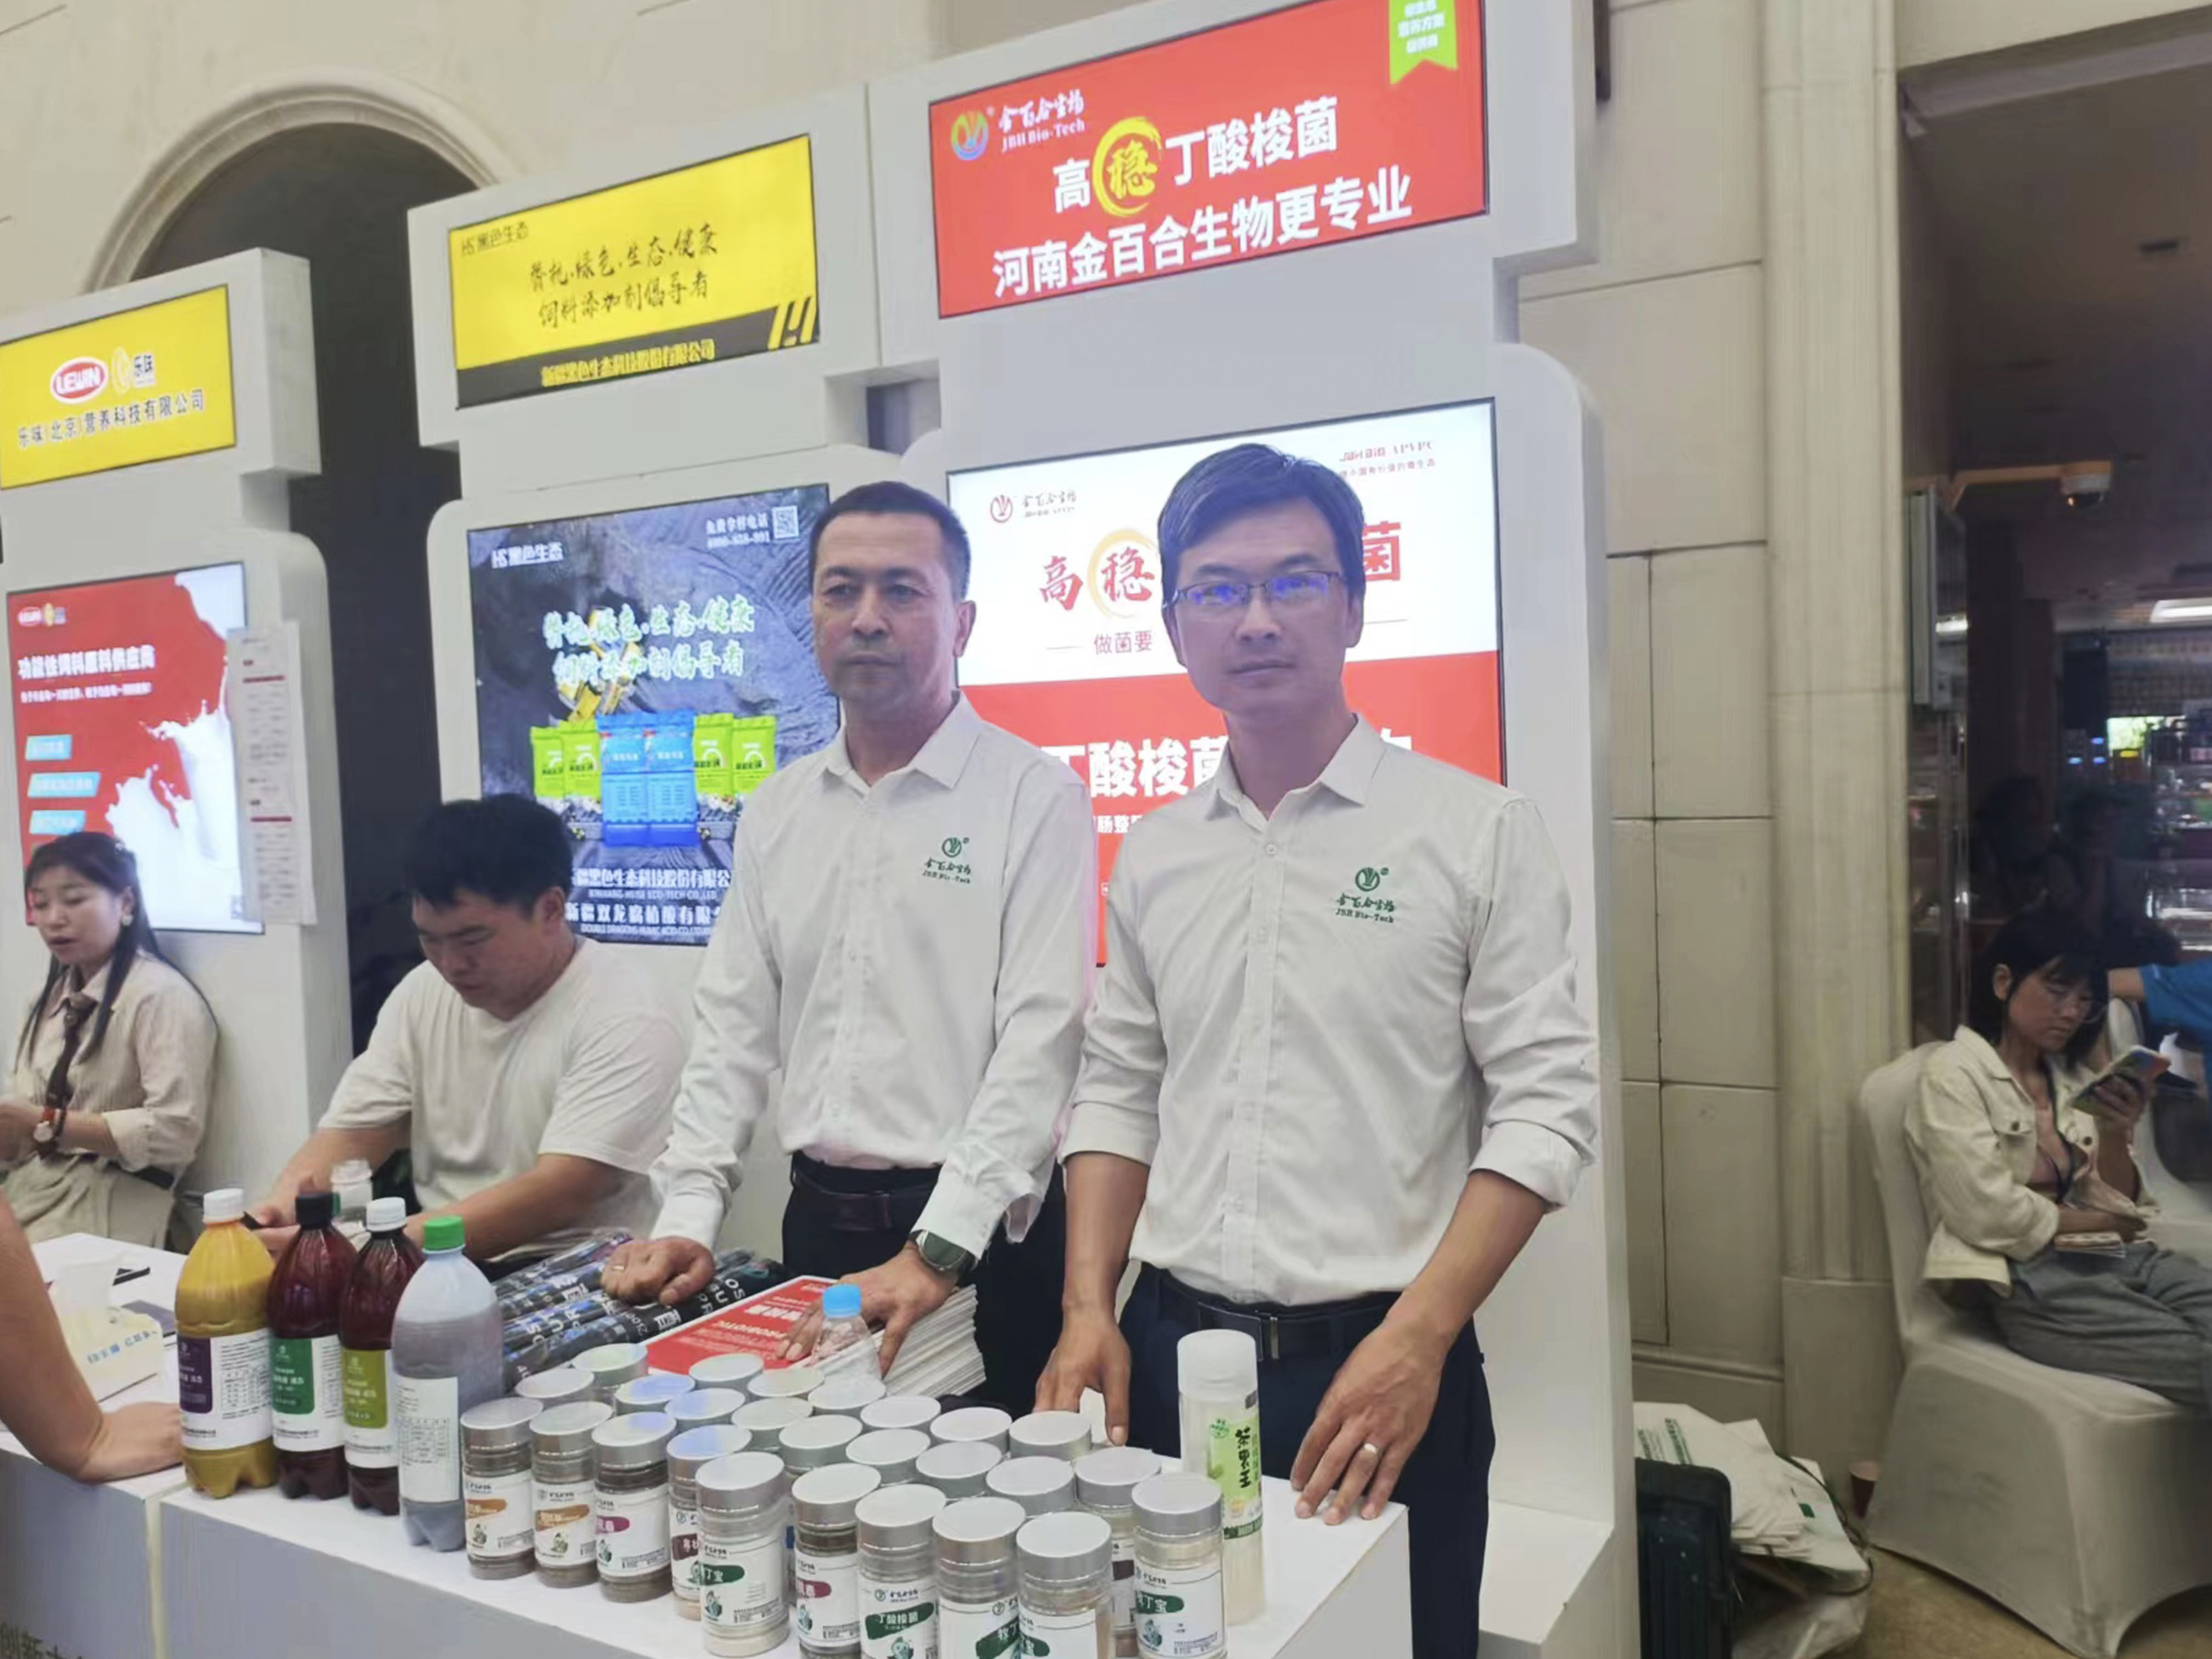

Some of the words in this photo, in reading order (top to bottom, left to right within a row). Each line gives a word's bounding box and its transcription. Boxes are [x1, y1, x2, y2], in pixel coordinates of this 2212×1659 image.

[993, 165, 1411, 298] 河南金百合生物更专业
